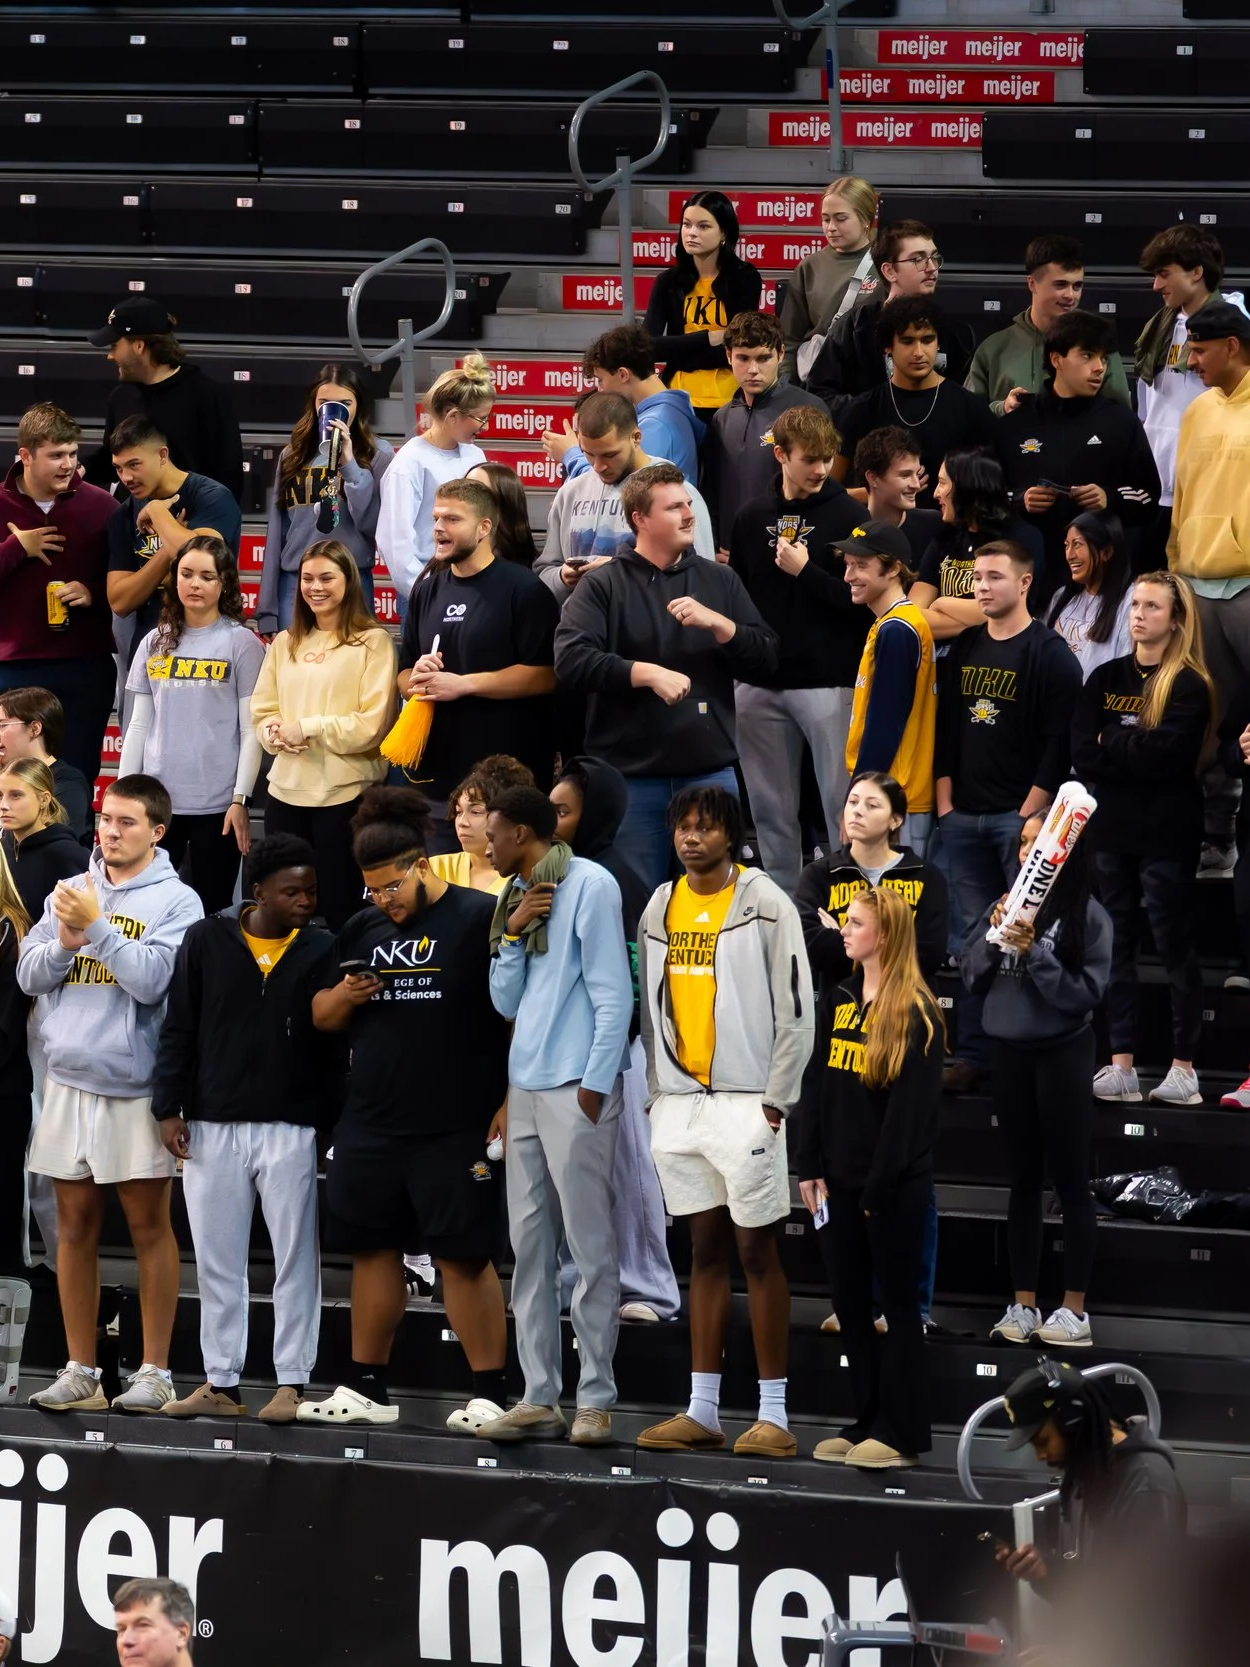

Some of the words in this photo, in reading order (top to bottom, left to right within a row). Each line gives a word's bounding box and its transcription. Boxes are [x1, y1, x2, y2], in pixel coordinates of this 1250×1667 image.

[891, 35, 947, 59] meijer
[965, 36, 1021, 60] meijer
[1039, 37, 1083, 61] meije
[908, 74, 965, 99] meijer
[983, 75, 1040, 99] meijer
[782, 117, 830, 139] meije
[856, 117, 913, 141] meijer
[931, 117, 982, 142] meije
[757, 197, 814, 221] meijer
[633, 236, 678, 262] meij
[735, 238, 765, 262] ijer
[576, 281, 623, 305] meije
[490, 365, 526, 390] eijer
[496, 409, 553, 435] meijer
[517, 456, 563, 483] meije
[572, 499, 623, 516] KENTU
[778, 521, 799, 533] NORS
[952, 559, 975, 567] NORTHE
[175, 659, 228, 680] NKU
[1028, 858, 1057, 899] ONE
[669, 931, 716, 949] ORTHE
[370, 939, 437, 967] NKU
[667, 949, 715, 966] ENTUC
[420, 977, 432, 987] OF
[383, 991, 392, 1000] &
[395, 989, 442, 1000] Sciences
[419, 1507, 909, 1667] meijer
